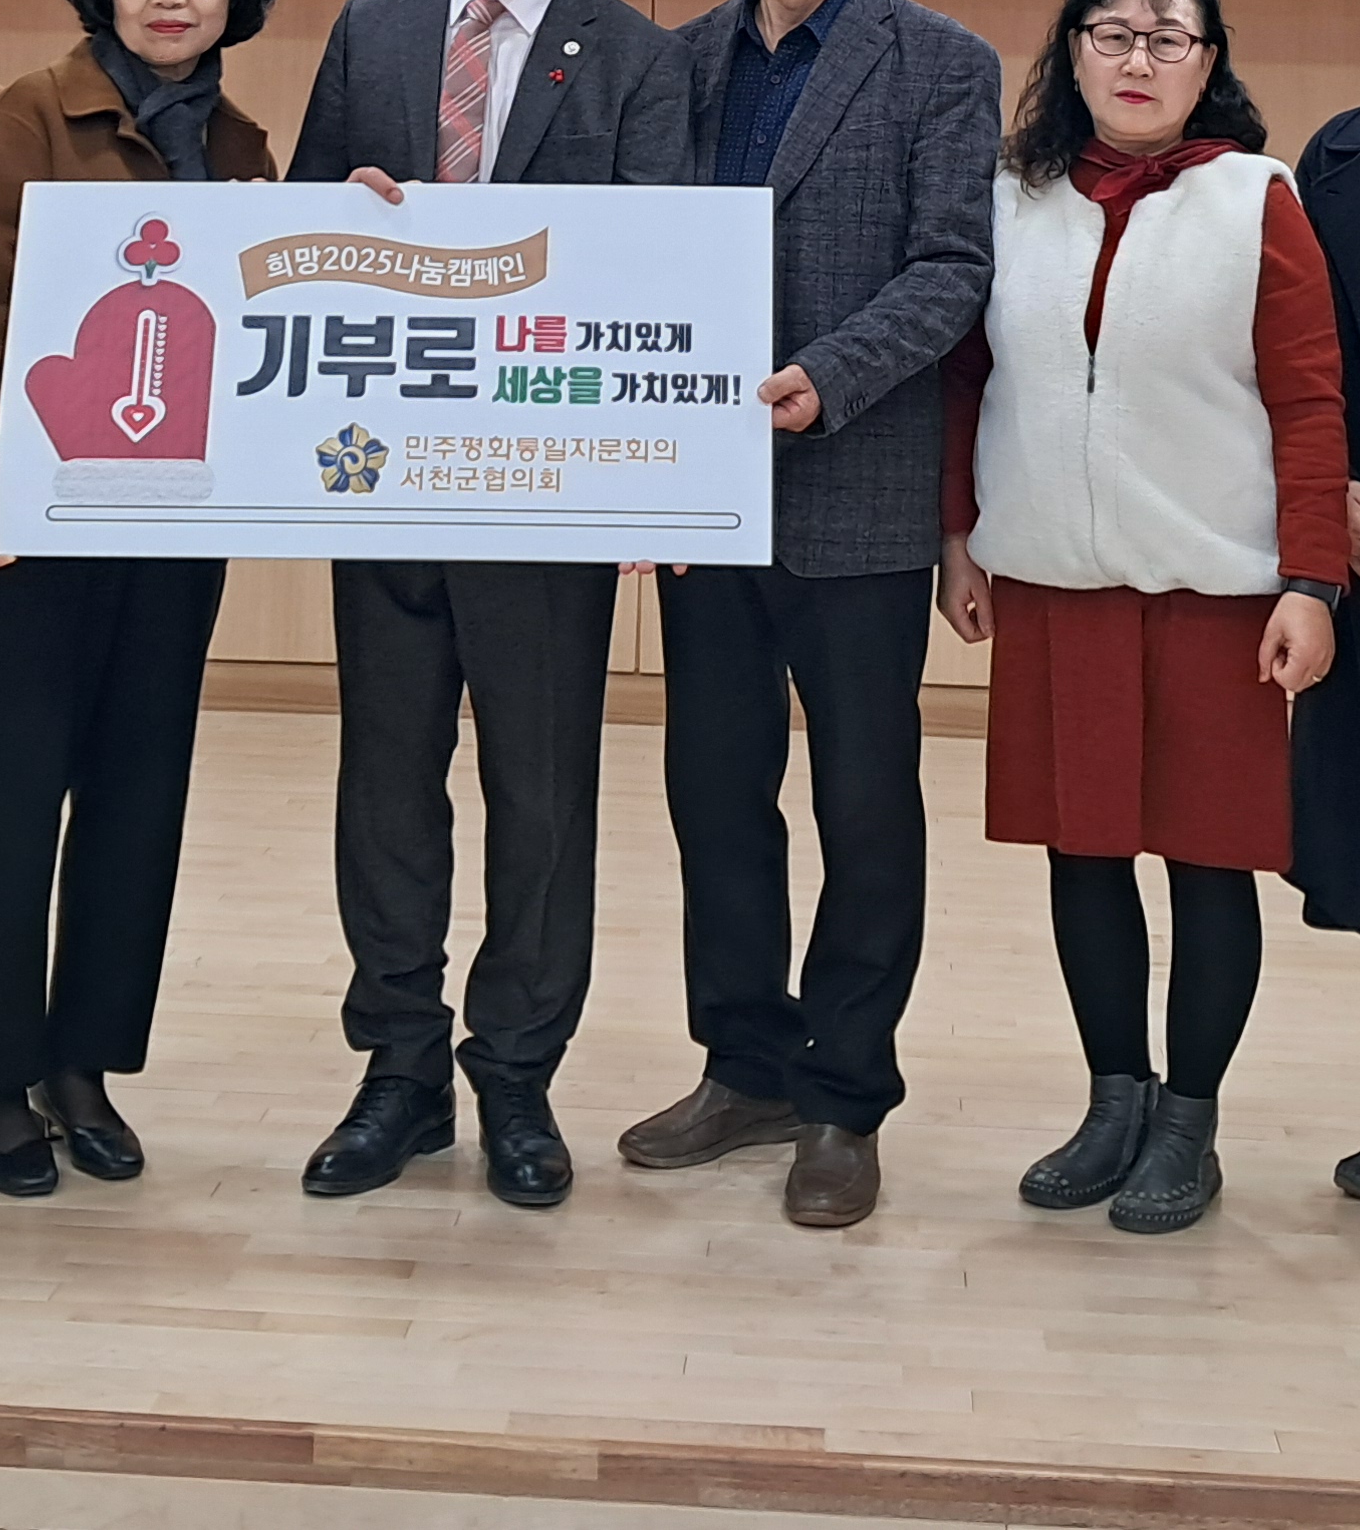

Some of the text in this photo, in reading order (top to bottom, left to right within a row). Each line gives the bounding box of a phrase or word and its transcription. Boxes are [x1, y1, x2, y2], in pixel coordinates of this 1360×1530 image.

[265, 245, 527, 287] 희망2025나눔캠페인
[496, 315, 693, 353] 나를 가치있게
[236, 315, 479, 398] 기부로
[492, 366, 741, 406] 세상을 가치있게!
[405, 436, 678, 464] 민주평화통일자문회의
[400, 466, 562, 493] 서천군협의회
